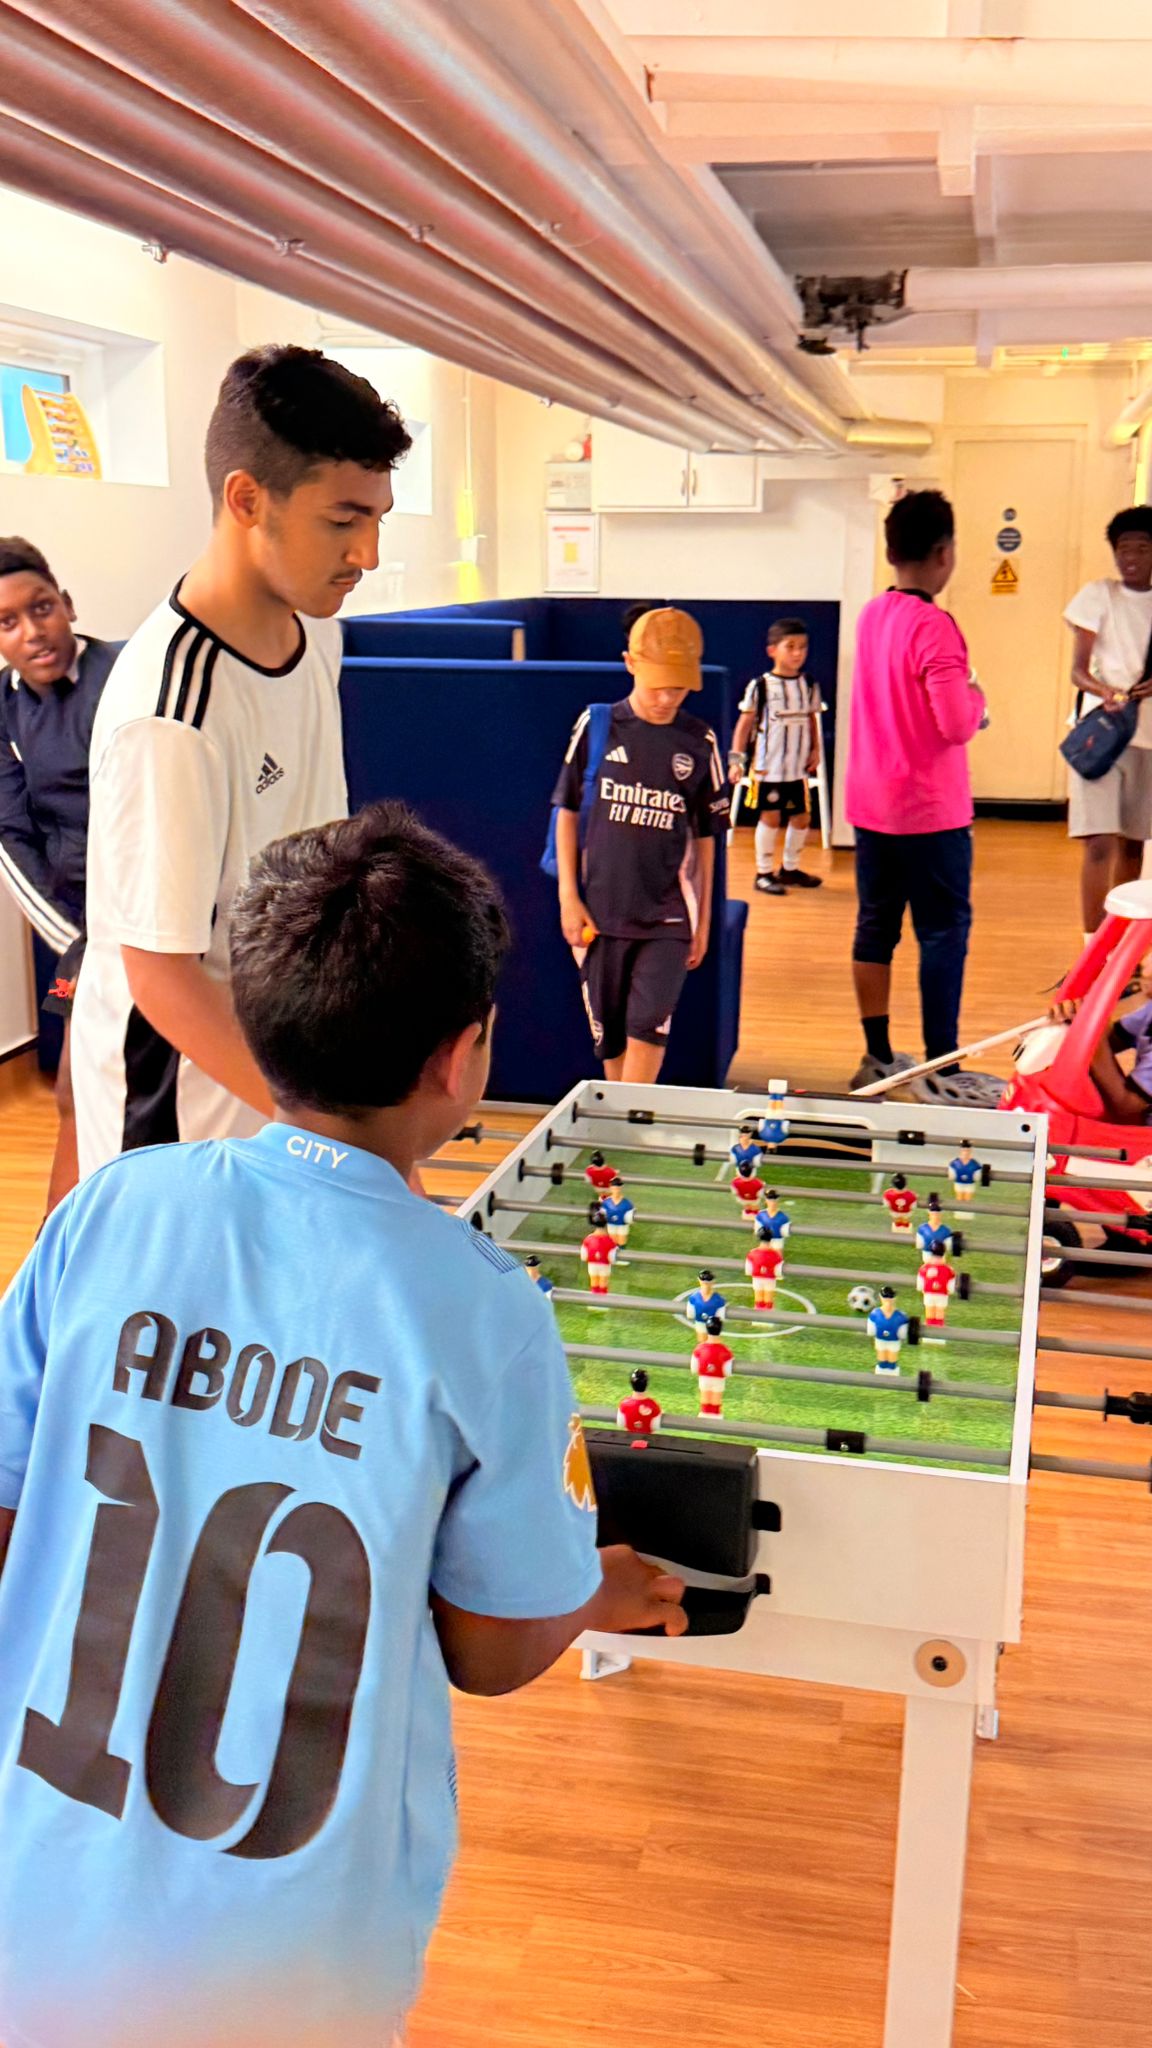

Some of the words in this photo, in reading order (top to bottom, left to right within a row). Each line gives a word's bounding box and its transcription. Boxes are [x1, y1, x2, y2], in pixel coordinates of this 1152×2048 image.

[256, 767, 284, 794] adidas
[600, 777, 687, 813] Emirates
[608, 803, 631, 823] FLY
[630, 804, 674, 831] BETTER
[286, 1135, 349, 1169] CITY
[112, 1310, 382, 1461] ABODE
[16, 1423, 371, 1860] 10
